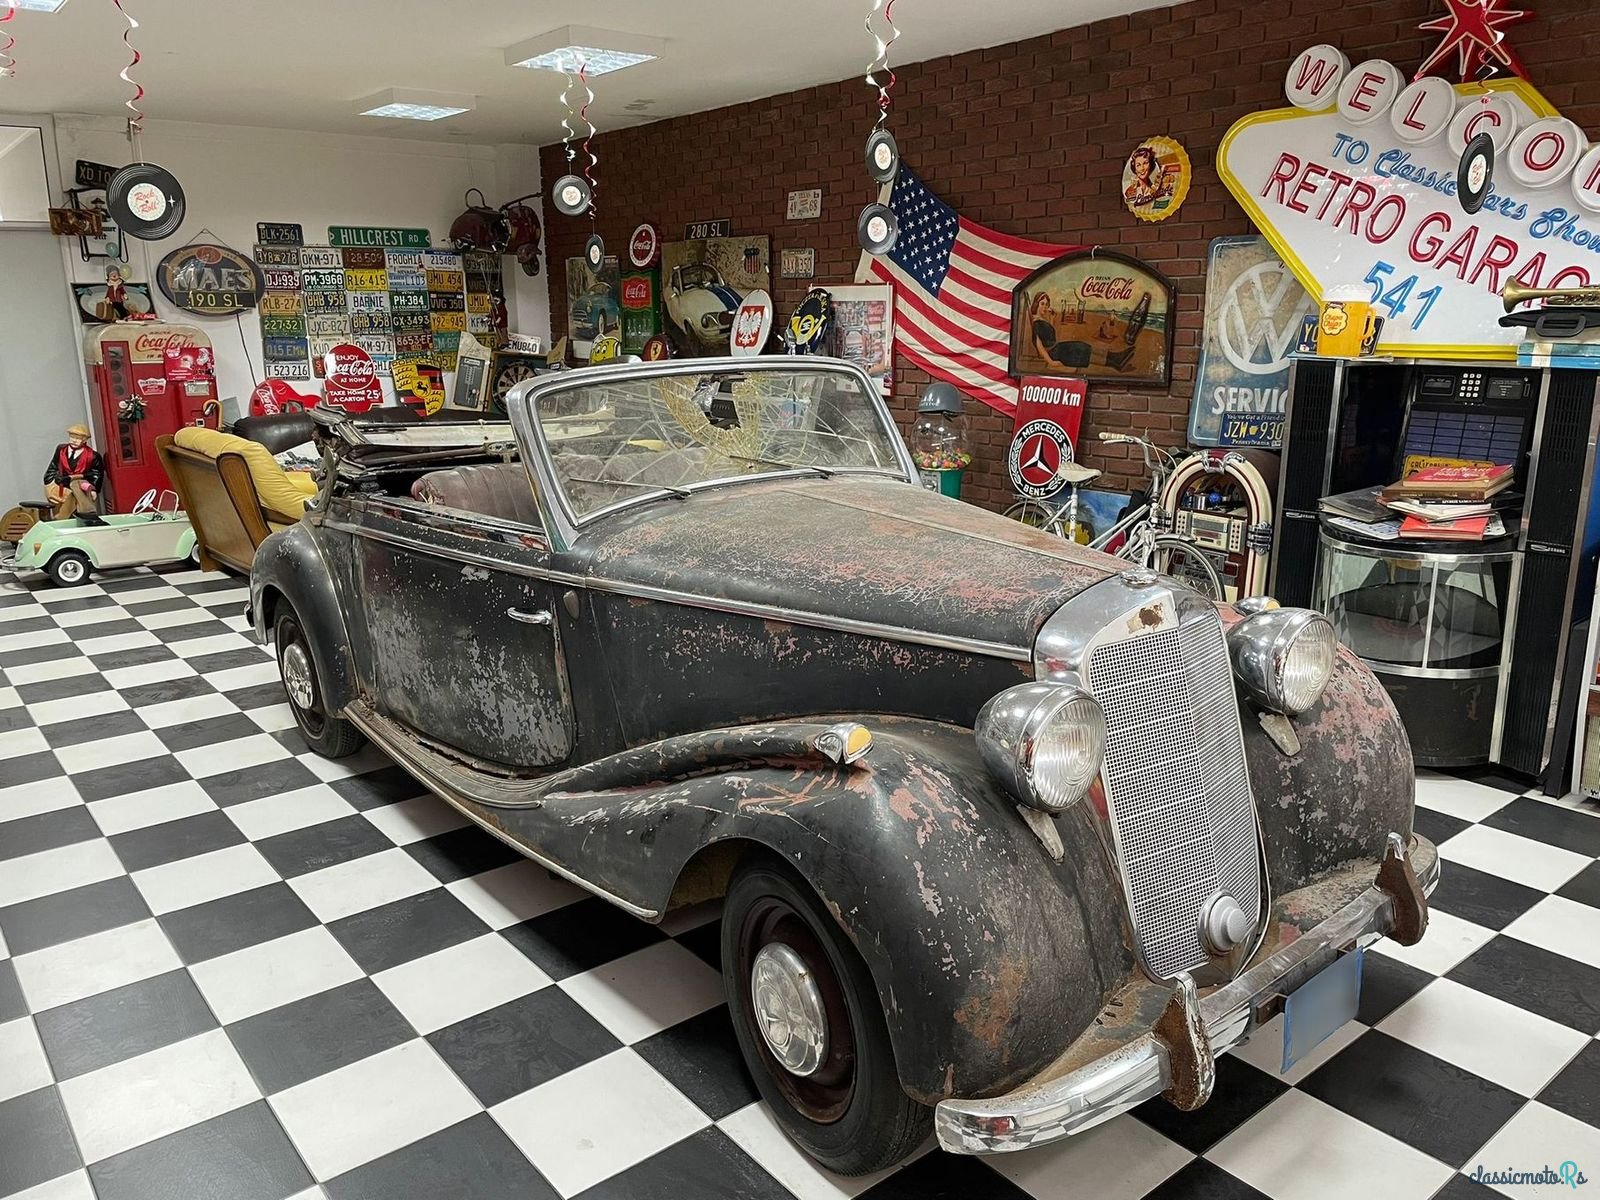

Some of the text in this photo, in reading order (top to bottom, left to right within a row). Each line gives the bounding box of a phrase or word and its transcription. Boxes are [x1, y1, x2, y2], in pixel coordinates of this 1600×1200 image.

[1332, 132, 1370, 165] TO
[1373, 149, 1457, 197] Classic
[1482, 182, 1528, 221] ars
[134, 187, 155, 201] Rock
[1261, 152, 1407, 245] RETRO
[139, 201, 158, 213] Roll
[340, 228, 404, 246] HILLCREST
[690, 222, 723, 239] 280 SL
[172, 266, 253, 291] MAES
[1081, 275, 1135, 300] Coca-Cola
[1363, 260, 1443, 332] 541
[223, 293, 243, 308] SL
[353, 295, 385, 308] BARNIE
[274, 365, 290, 377] 523
[292, 365, 308, 377] 216
[334, 360, 373, 375] ca-Cola
[1022, 385, 1081, 407] 100000 km
[1022, 422, 1066, 443] MERCEDES
[1023, 484, 1047, 497] BENZ
